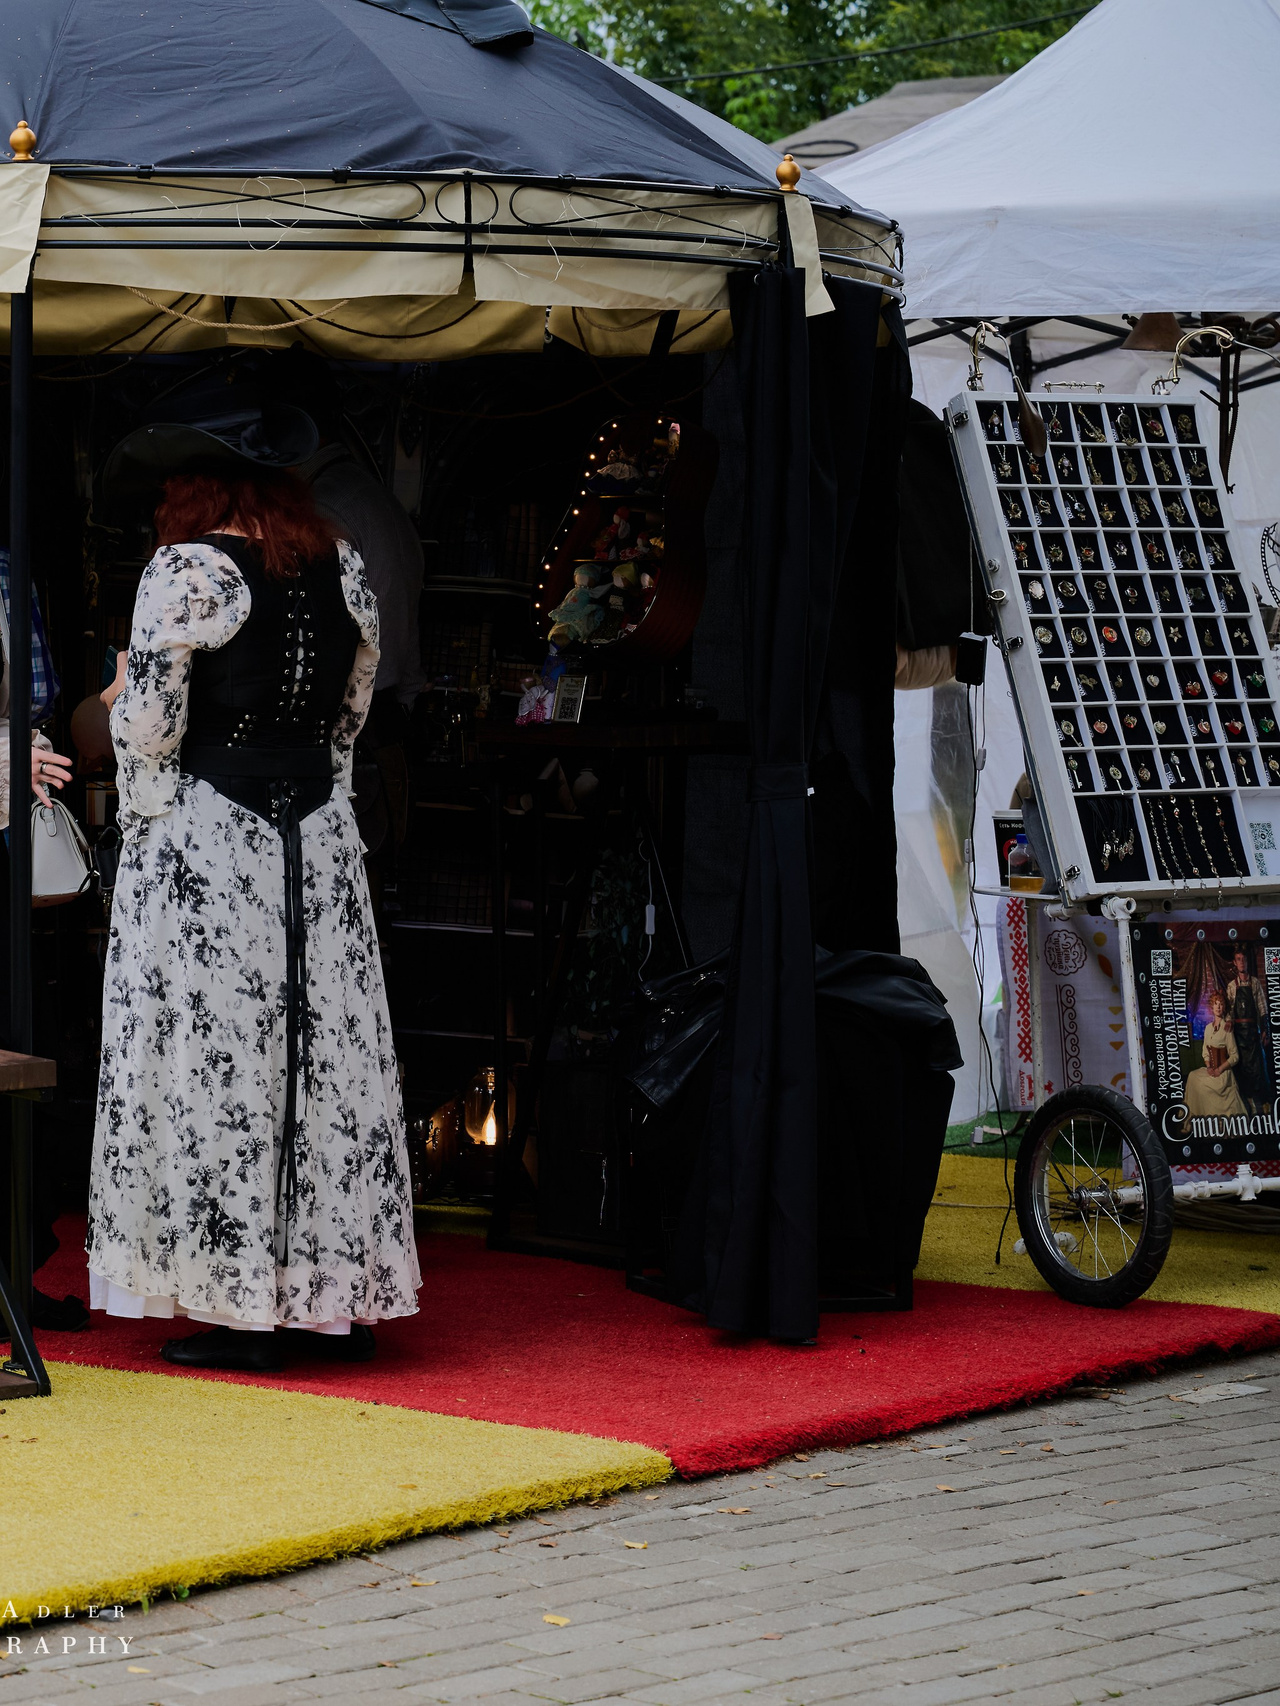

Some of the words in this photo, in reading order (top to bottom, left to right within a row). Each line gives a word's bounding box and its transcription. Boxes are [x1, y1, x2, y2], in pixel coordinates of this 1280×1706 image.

[1153, 1015, 1163, 1029] из
[1172, 978, 1190, 1048] ЛЯГУШКА
[1154, 1033, 1169, 1100] Украшения
